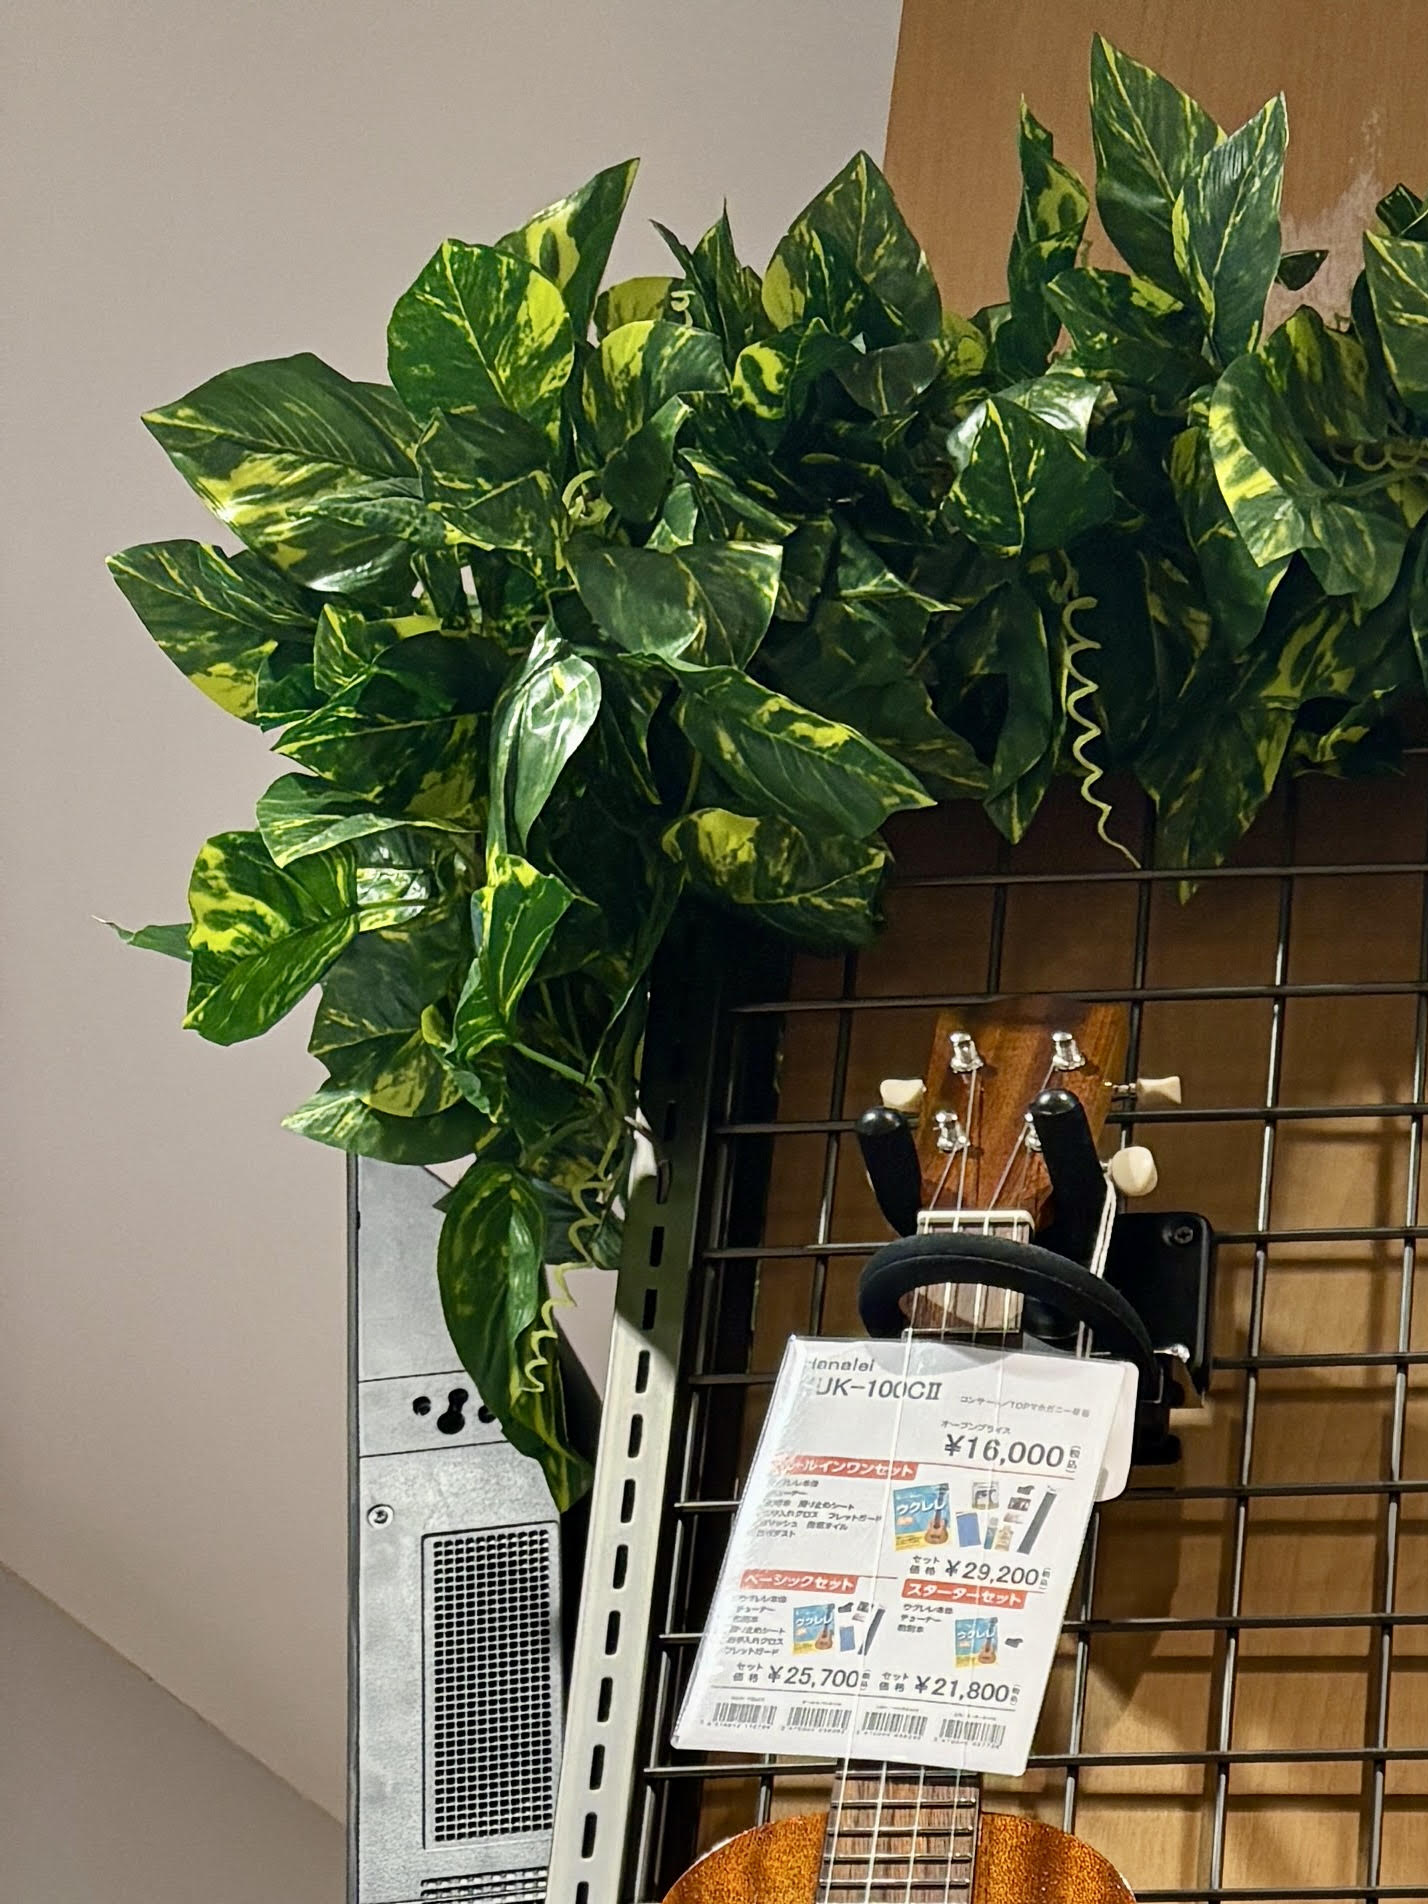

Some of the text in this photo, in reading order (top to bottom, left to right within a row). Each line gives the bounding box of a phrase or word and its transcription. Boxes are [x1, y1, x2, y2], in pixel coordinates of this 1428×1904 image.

[939, 1433, 1068, 1469] ¥16,000
[941, 1558, 1042, 1587] ¥29,200
[906, 1583, 1024, 1607] スターターセット
[765, 1663, 860, 1690] ¥25,700
[911, 1675, 1011, 1704] ¥21,800
